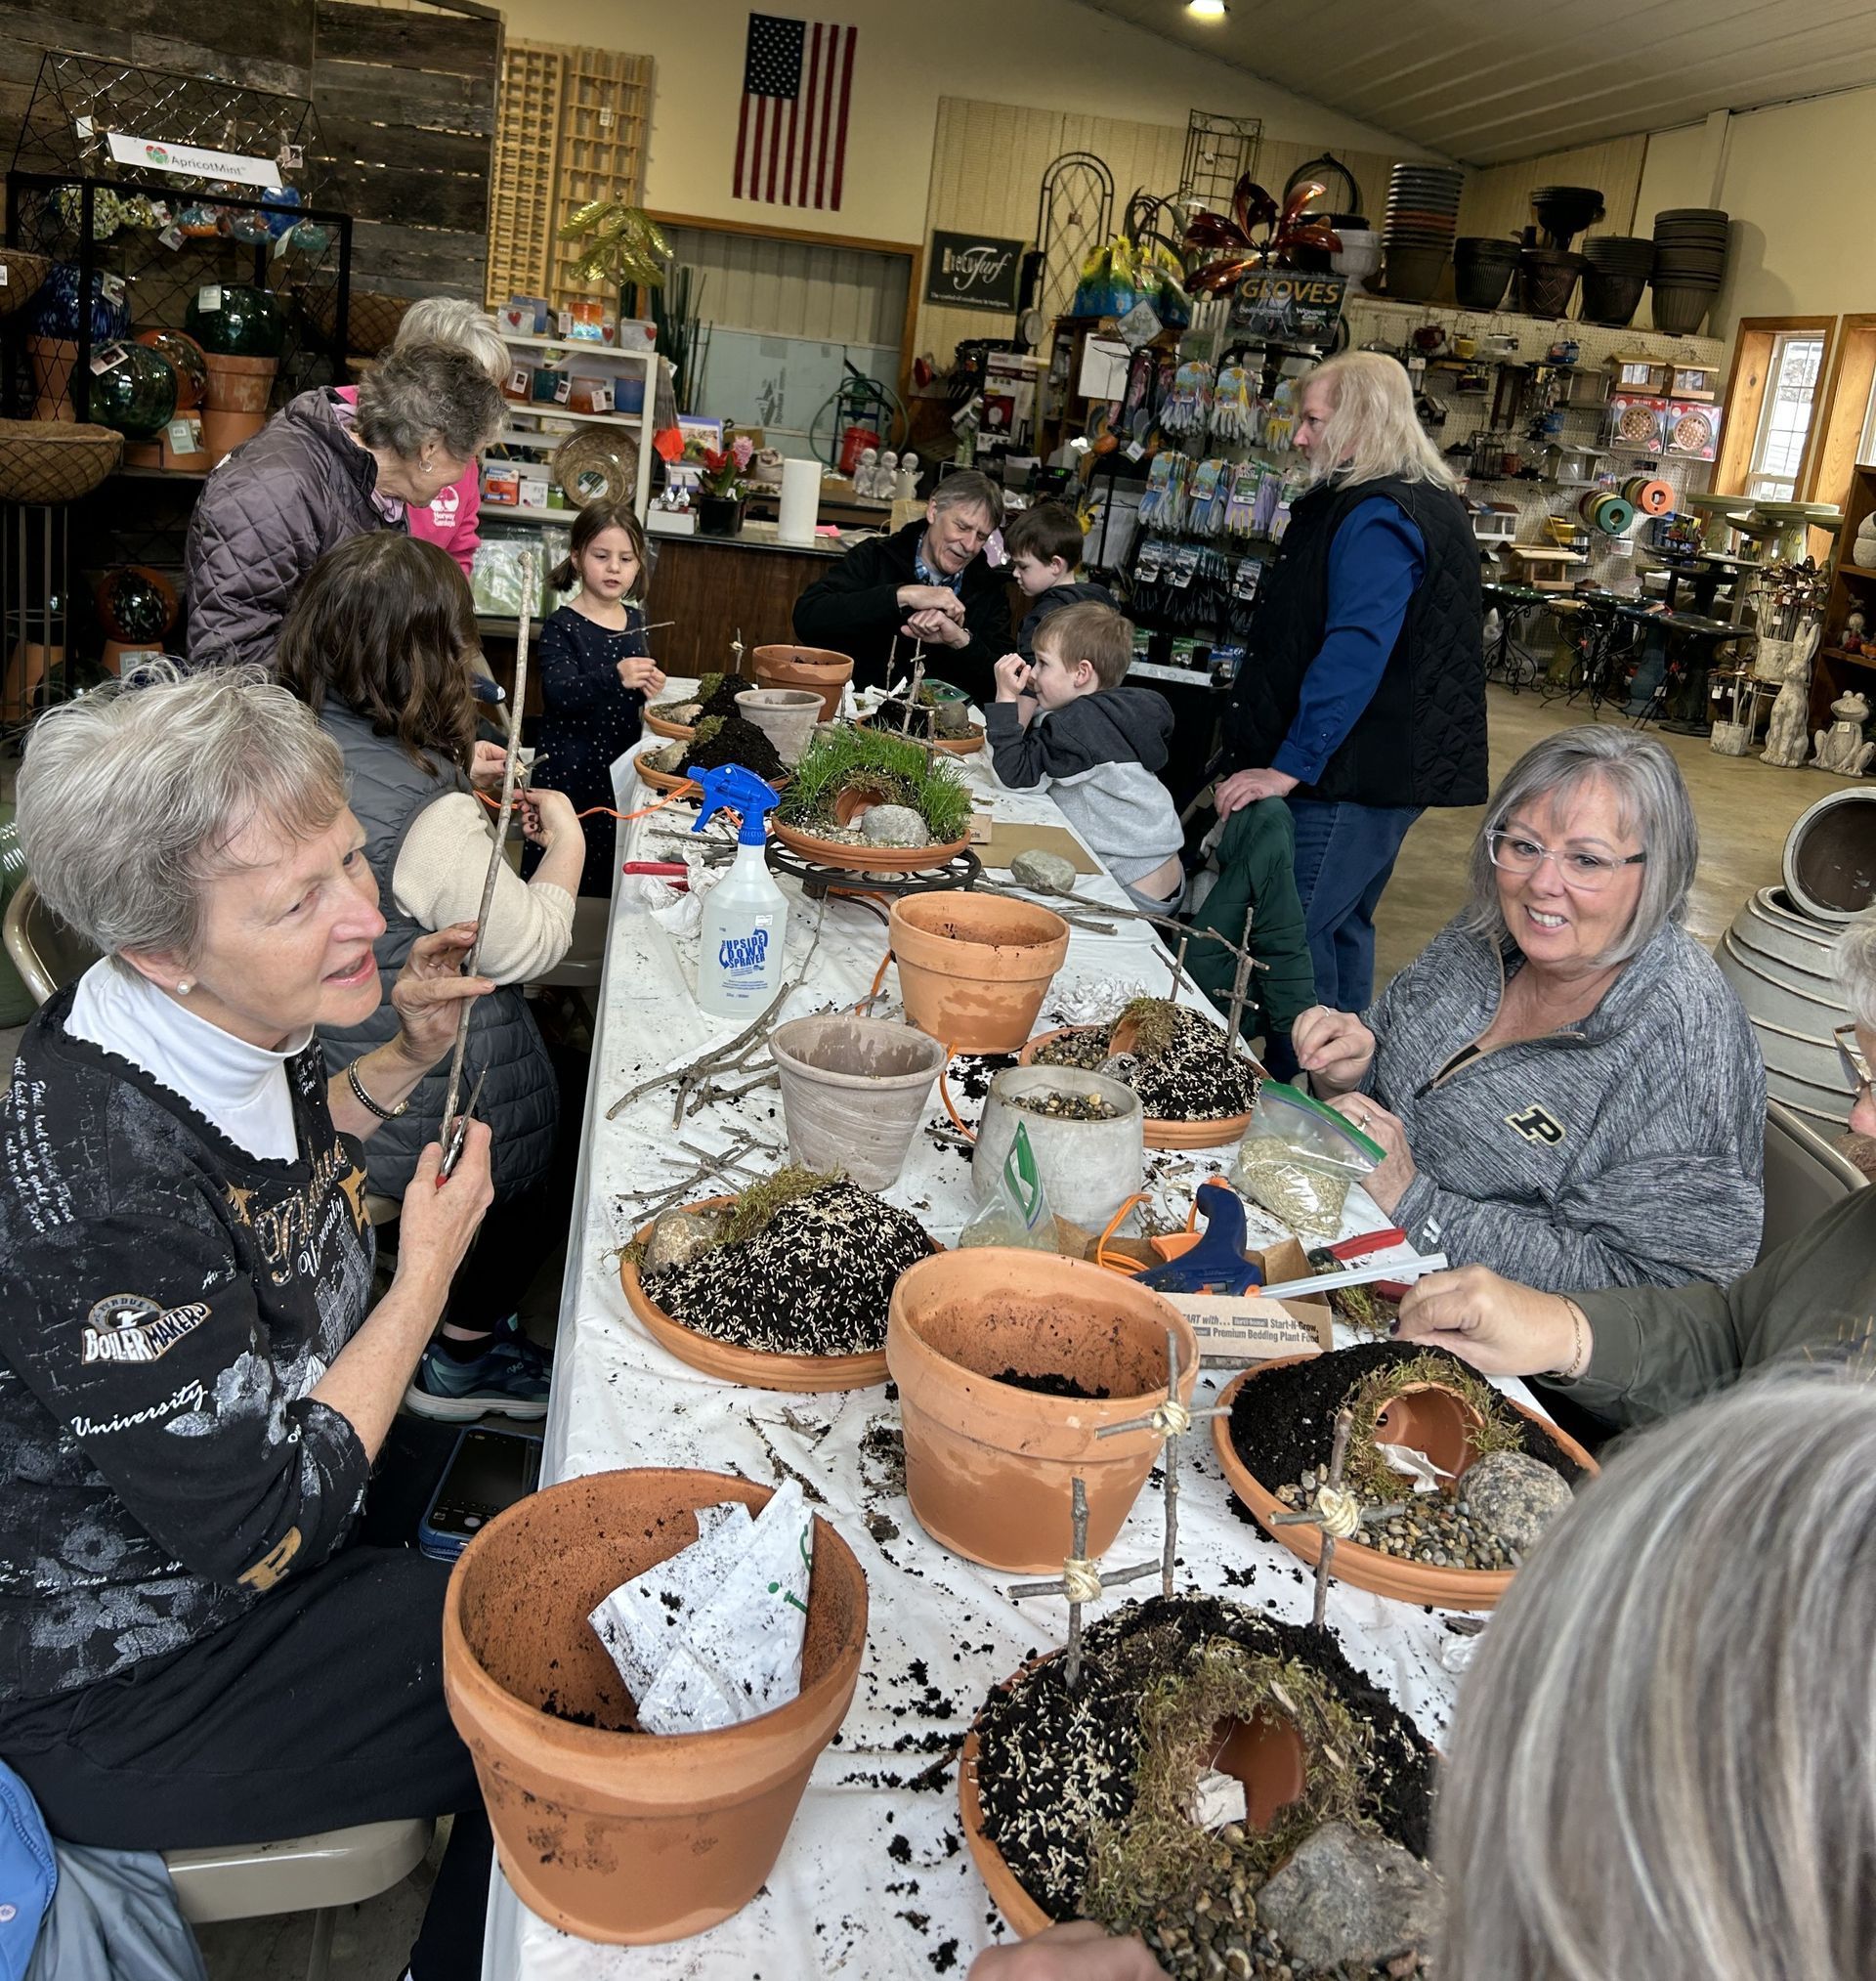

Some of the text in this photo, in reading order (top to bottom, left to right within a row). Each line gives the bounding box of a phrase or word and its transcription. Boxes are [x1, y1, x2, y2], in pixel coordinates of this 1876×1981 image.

[1241, 278, 1339, 304] GLOVES
[726, 934, 764, 950] UPSIDE
[727, 944, 764, 959] DOWN
[728, 953, 765, 969] SPRAYER
[1504, 1104, 1566, 1146] P
[1213, 1327, 1247, 1339] Premium
[1248, 1329, 1278, 1342] Bedding
[1280, 1332, 1300, 1342] Plant
[1301, 1332, 1320, 1344] Food
[70, 1379, 209, 1437] University
